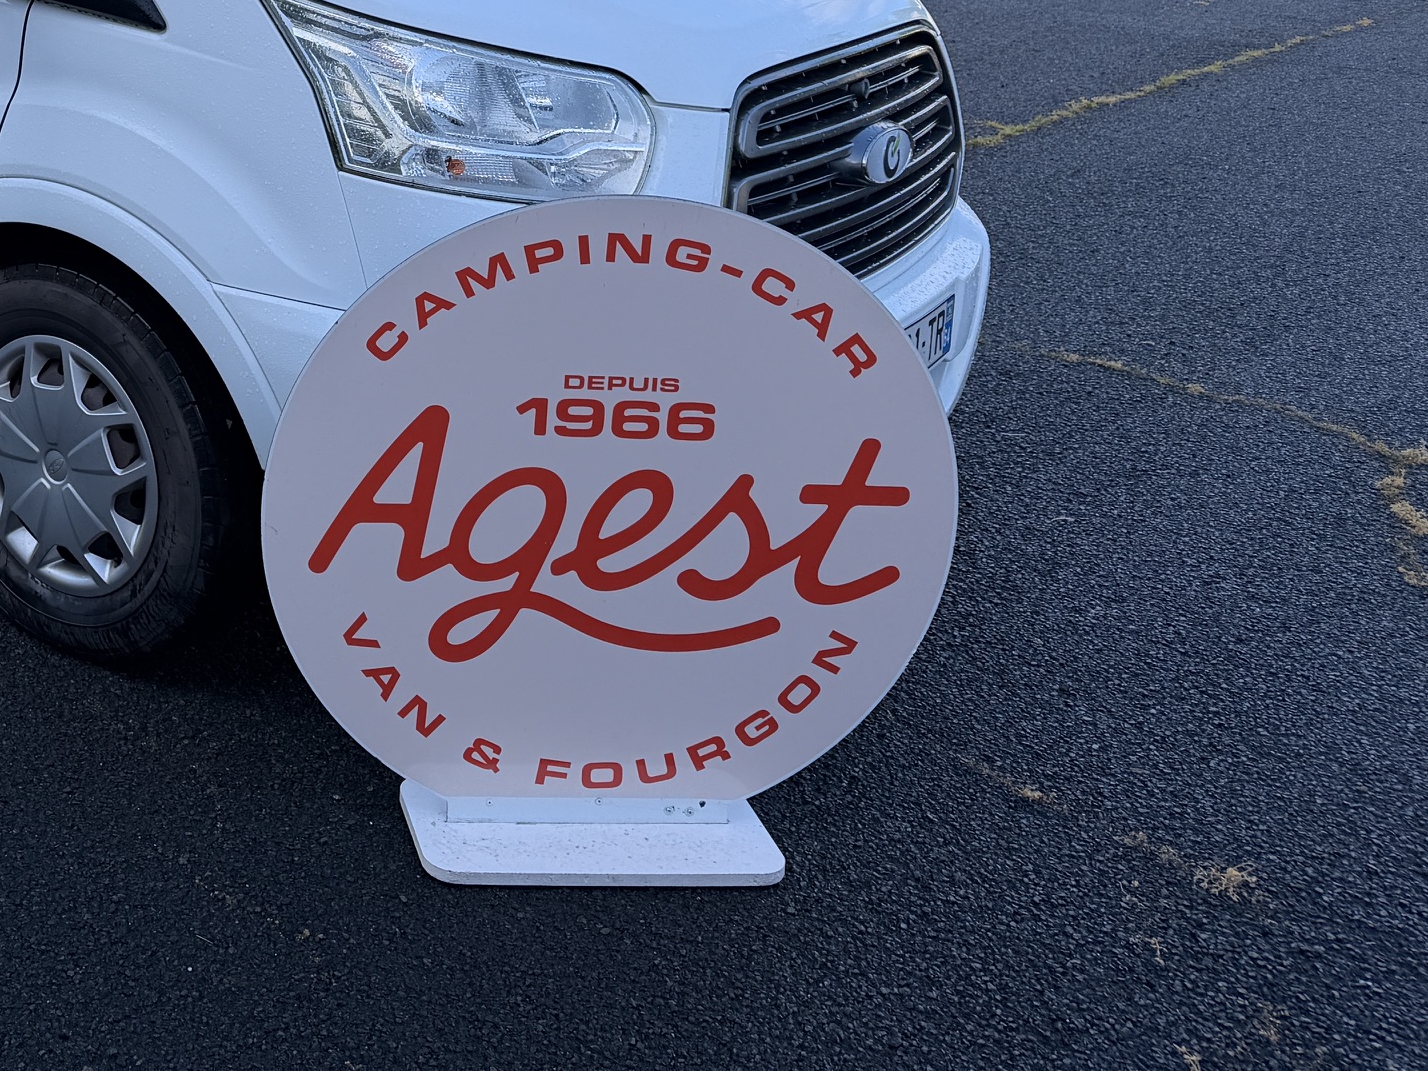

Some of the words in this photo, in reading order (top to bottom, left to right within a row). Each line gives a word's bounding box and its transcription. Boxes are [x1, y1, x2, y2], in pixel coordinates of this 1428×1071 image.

[366, 233, 877, 378] CAMPING-CAR
[516, 397, 717, 441] 1966
[564, 375, 680, 393] DEPUIS
[308, 405, 911, 663] Agest
[344, 613, 446, 738] VAN
[463, 738, 501, 773] &
[536, 631, 857, 789] FOURGON
